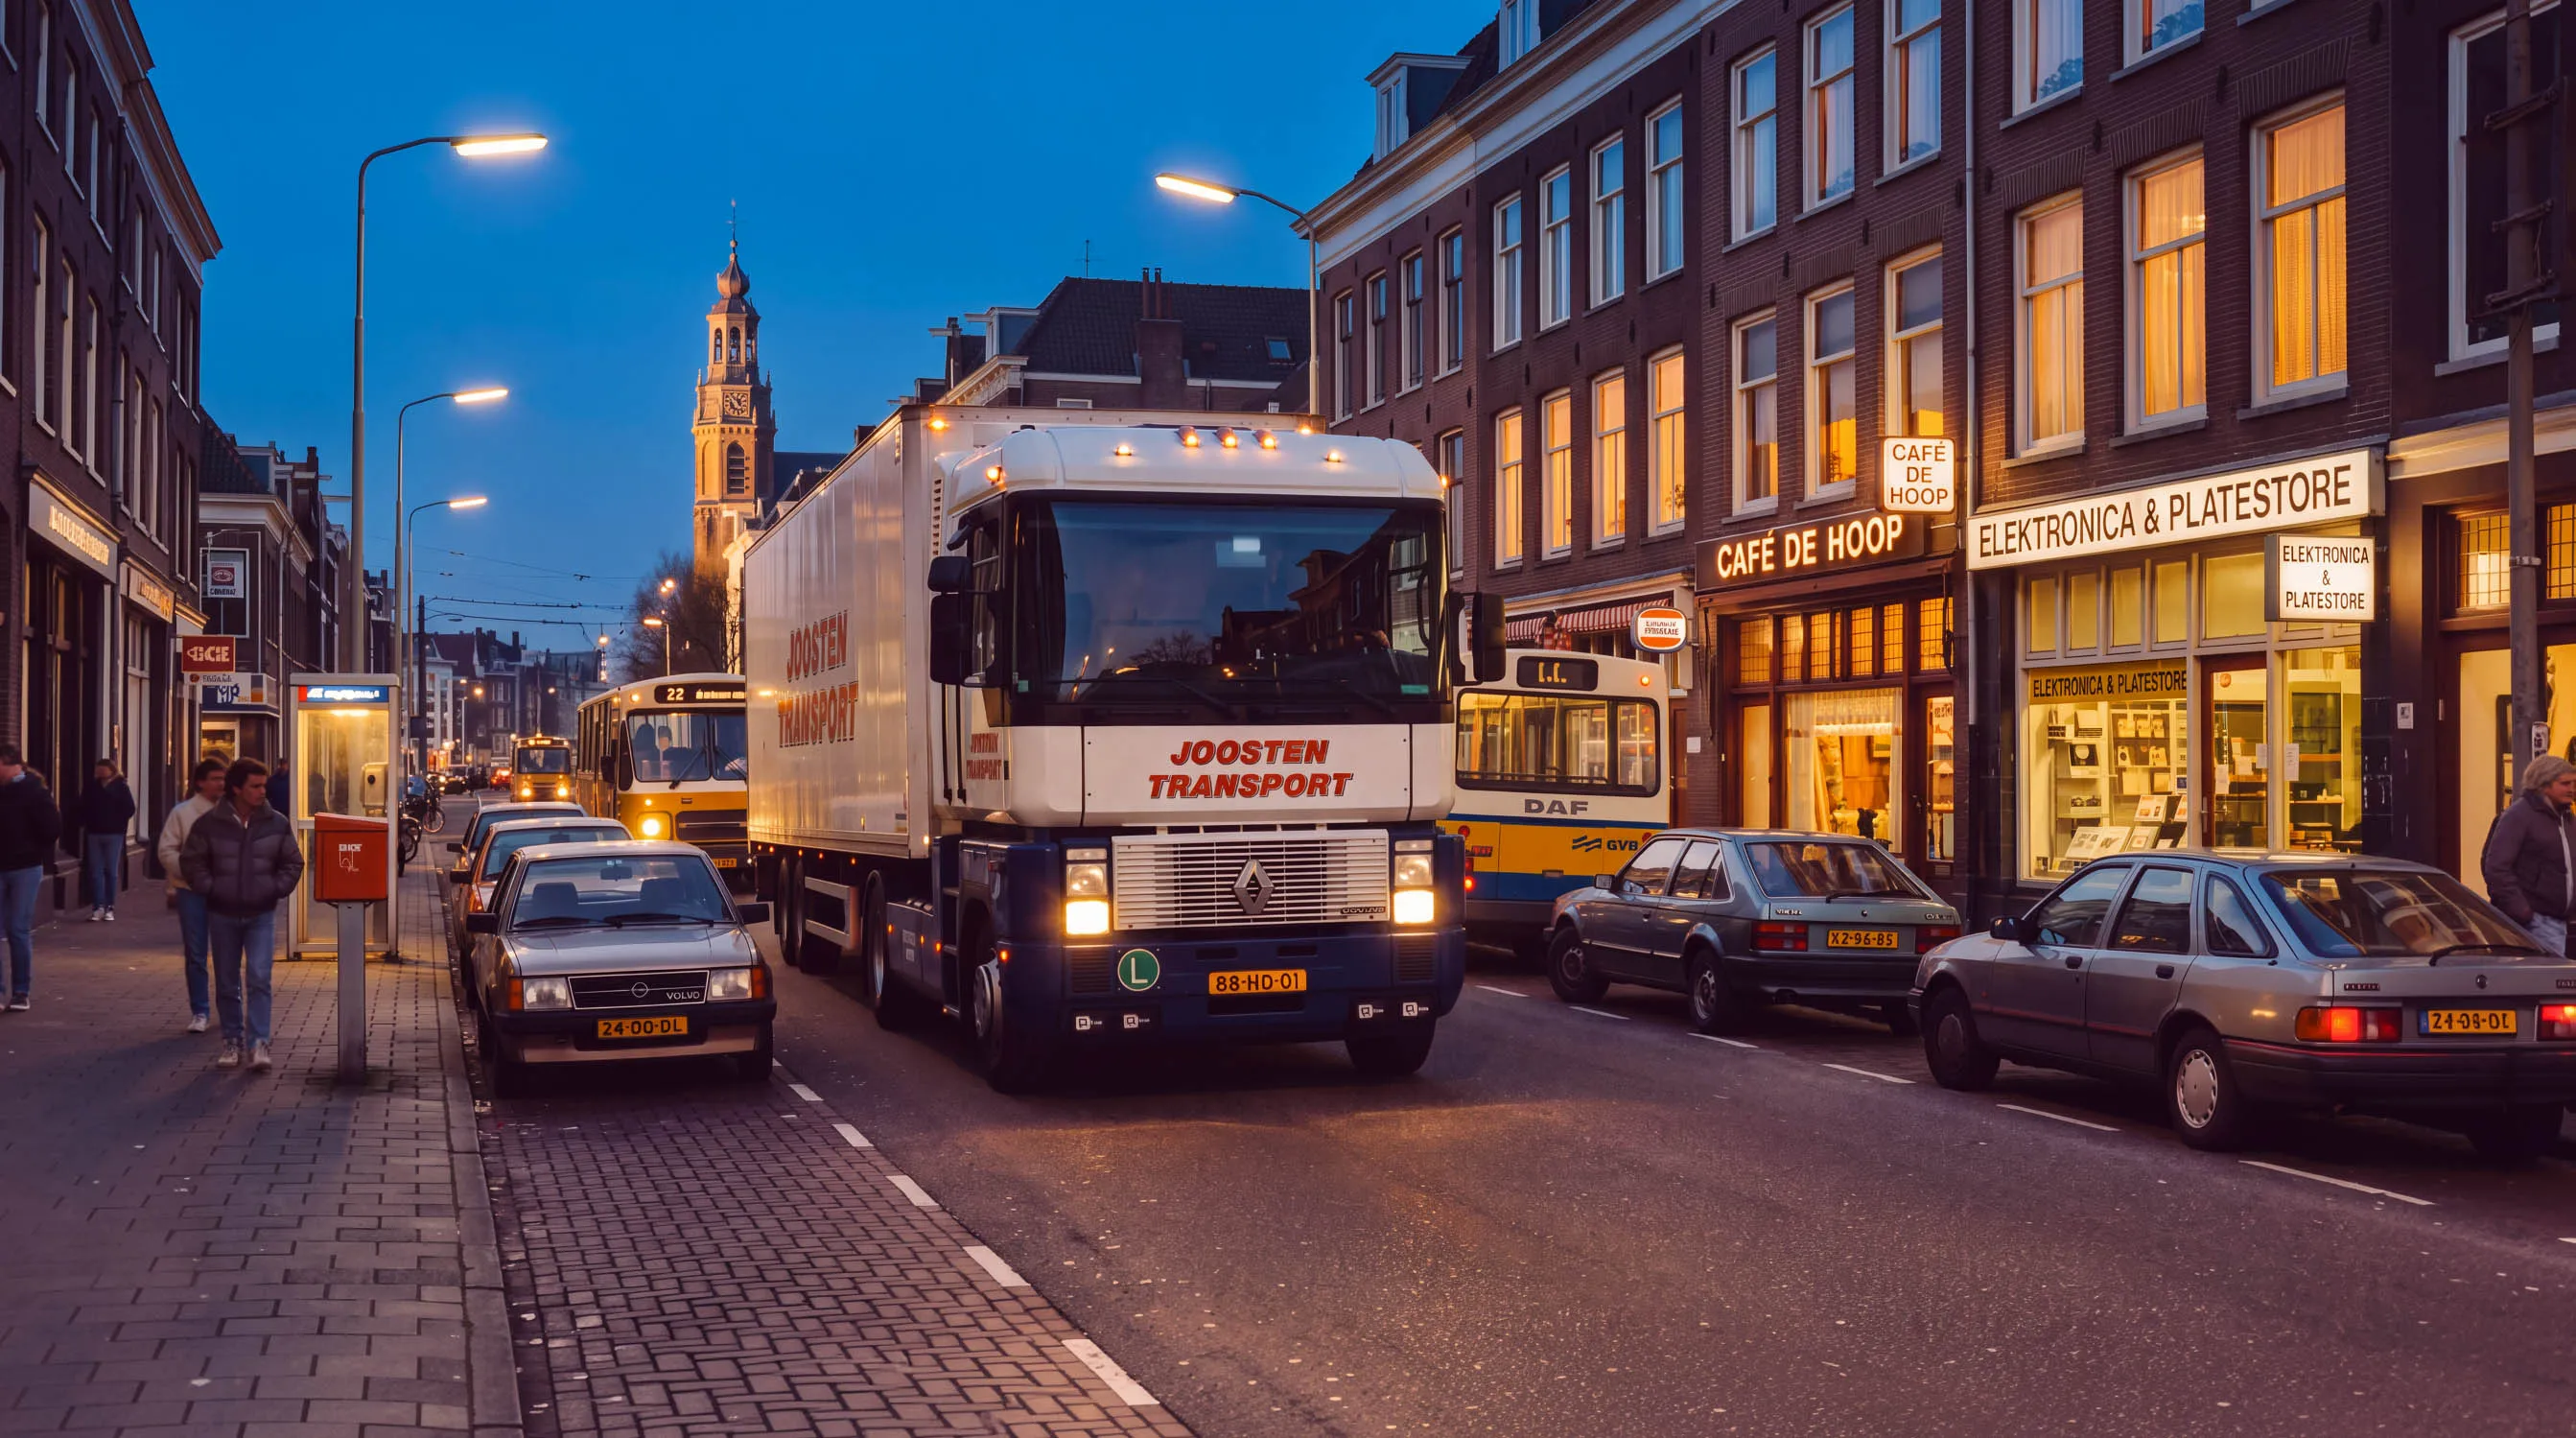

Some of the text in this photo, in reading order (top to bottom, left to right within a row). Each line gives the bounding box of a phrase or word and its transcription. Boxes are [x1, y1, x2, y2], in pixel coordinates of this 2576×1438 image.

[1892, 440, 1946, 462] CAFÉ
[1907, 466, 1932, 483] DE
[1890, 487, 1948, 505] HOOP
[1979, 464, 2352, 558] ELEKTRONICA & PLATESTORE
[1717, 514, 1903, 578] CAFÉ DE HOOP
[2283, 545, 2370, 564] ELEKTRONICA
[2322, 569, 2331, 586] &
[2285, 591, 2365, 609] PLATESTORE
[786, 609, 849, 683] JOOSTEN
[2033, 669, 2187, 697] ELEKTRONICA & PLATESTORE
[667, 687, 685, 701] 22
[778, 680, 859, 748] TRANSPORT
[1170, 740, 1330, 766] JOOSTEN
[1149, 772, 1354, 799] TRANSPORT
[1524, 798, 1589, 814] DAF
[1606, 839, 1639, 851] GVB
[1131, 956, 1149, 983] L
[1215, 972, 1300, 992] 88-HD-01
[666, 991, 700, 1000] VOLVO
